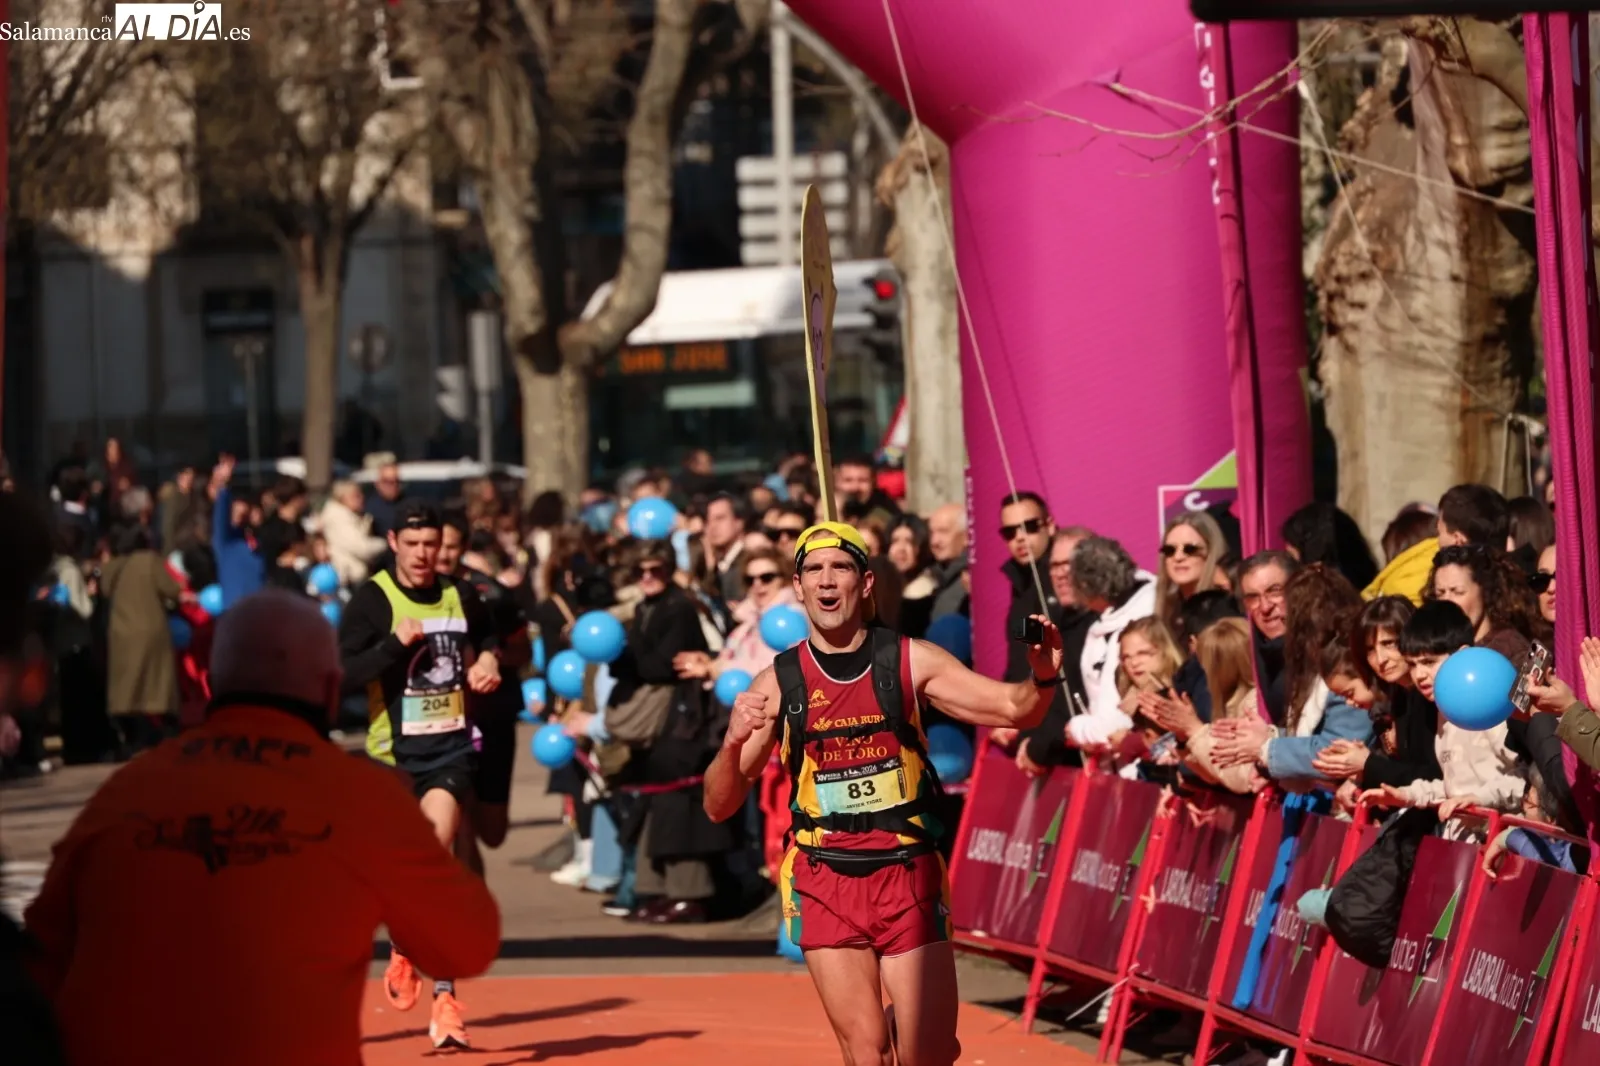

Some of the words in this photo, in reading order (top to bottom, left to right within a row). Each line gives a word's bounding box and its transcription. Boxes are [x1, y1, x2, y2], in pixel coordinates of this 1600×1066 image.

[422, 697, 451, 711] 204
[834, 716, 859, 727] CAJA
[823, 751, 842, 762] DE
[845, 746, 888, 760] TORO
[847, 780, 876, 799] 83
[1461, 947, 1505, 1002] LABORAL
[1497, 965, 1524, 1011] kutxa
